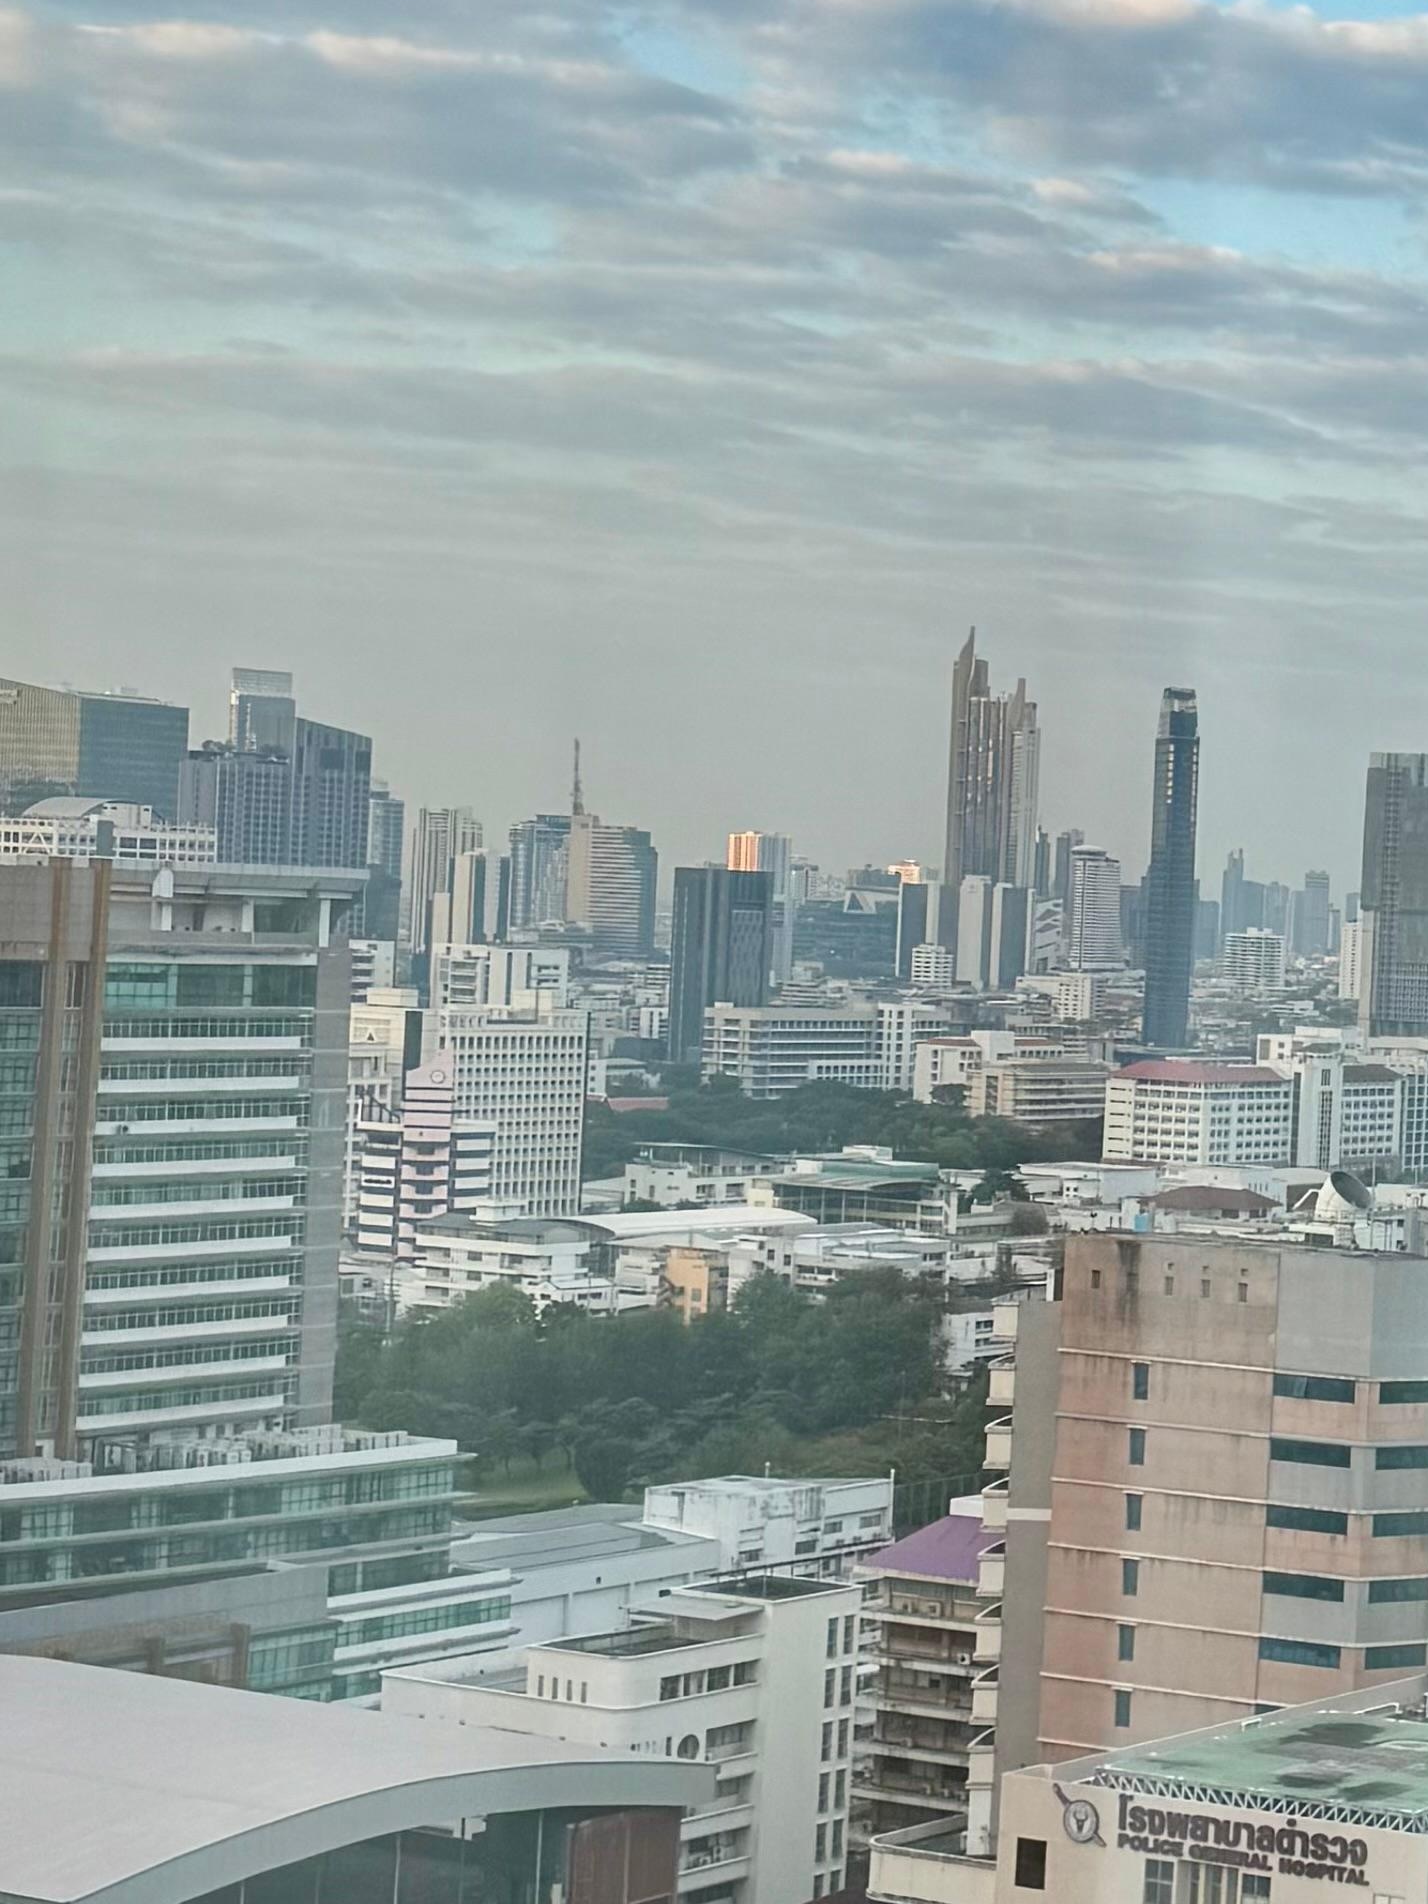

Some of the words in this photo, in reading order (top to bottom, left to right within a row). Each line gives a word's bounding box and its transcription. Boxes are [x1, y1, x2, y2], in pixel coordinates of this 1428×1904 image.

[1117, 1833, 1184, 1857] POLICE
[1188, 1843, 1273, 1871] GENERAL
[1278, 1857, 1370, 1886] HOSPITAL
[1118, 1793, 1369, 1866] โรงพยาบาลตำรวจ
